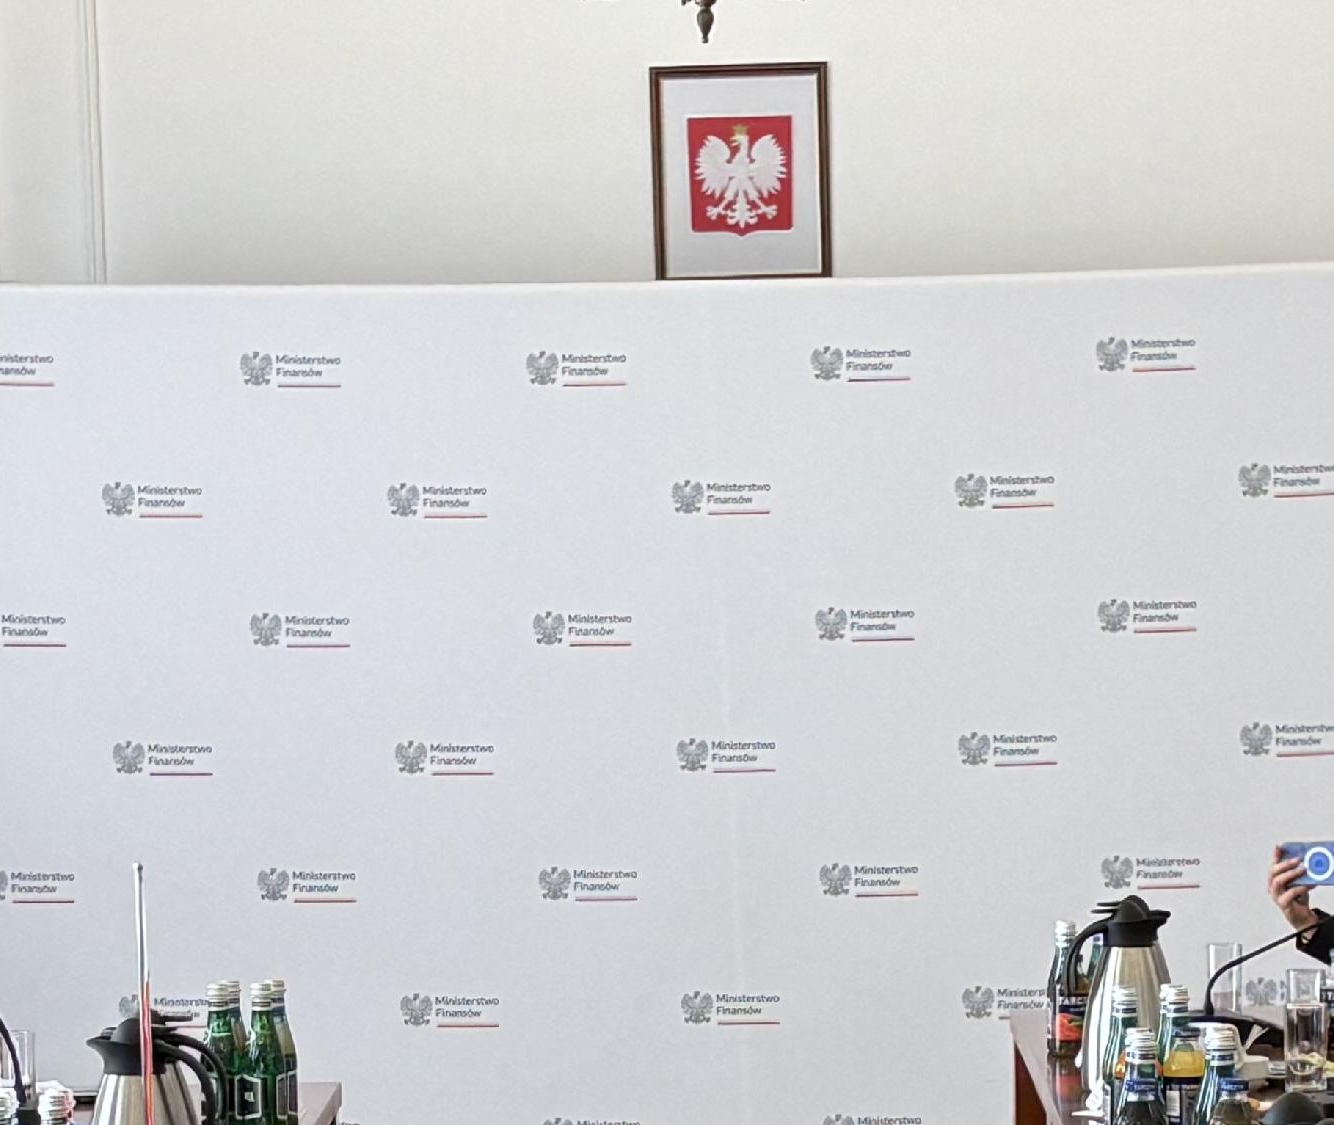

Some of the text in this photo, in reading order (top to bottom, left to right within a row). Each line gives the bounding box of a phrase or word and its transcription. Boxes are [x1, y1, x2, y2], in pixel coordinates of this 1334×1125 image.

[1130, 338, 1197, 349] Ministerstwo
[561, 353, 627, 364] Ministerstwo
[845, 348, 912, 359] Ministerstwo
[1130, 351, 1178, 361] Finansów
[275, 354, 342, 366] Ministerstwo
[275, 367, 323, 377] Finansów
[561, 366, 609, 376] Finansów
[845, 361, 894, 372] Finansów
[989, 475, 1056, 485] Ministerstwo
[1272, 476, 1321, 488] Finansów
[137, 485, 203, 496] Ministerstwo
[422, 486, 488, 496] Ministerstwo
[706, 482, 772, 493] Ministerstwo
[989, 488, 1037, 498] Finansów
[137, 497, 186, 508] Finansów
[422, 497, 470, 508] Finansów
[706, 494, 753, 505] Finansów
[1132, 600, 1198, 611] Ministerstwo
[1, 614, 67, 625] Ministerstwo
[567, 614, 633, 624] Ministerstwo
[849, 609, 916, 620] Ministerstwo
[1132, 613, 1179, 623] Finansów
[284, 615, 351, 626] Ministerstwo
[849, 621, 897, 631] Finansów
[1, 626, 49, 637] Finansów
[285, 627, 333, 638] Finansów
[567, 626, 615, 637] Finansów
[992, 734, 1058, 744] Ministerstwo
[1275, 736, 1322, 747] Finansów
[147, 743, 213, 754] Ministerstwo
[429, 743, 495, 754] Ministerstwo
[710, 740, 776, 751] Ministerstwo
[992, 746, 1040, 757] Finansów
[148, 755, 195, 766] Finansów
[429, 755, 477, 766] Finansów
[710, 753, 758, 763] Finansów
[1135, 857, 1201, 868] Ministerstwo
[572, 869, 638, 879] Ministerstwo
[853, 865, 919, 875] Ministerstwo
[1135, 869, 1184, 879] Finansów
[10, 871, 75, 882] Ministerstwo
[291, 871, 356, 881] Ministerstwo
[573, 881, 620, 892] Finansów
[853, 877, 901, 887] Finansów
[10, 883, 58, 894] Finansów
[292, 883, 339, 893] Finansów
[153, 997, 209, 1007] Ministerst
[434, 996, 500, 1006] Ministerstwo
[715, 993, 781, 1003] Ministerstwo
[434, 1007, 482, 1018] Finansów
[716, 1005, 762, 1016] Finansów
[857, 1116, 922, 1125] Ministerstwo
